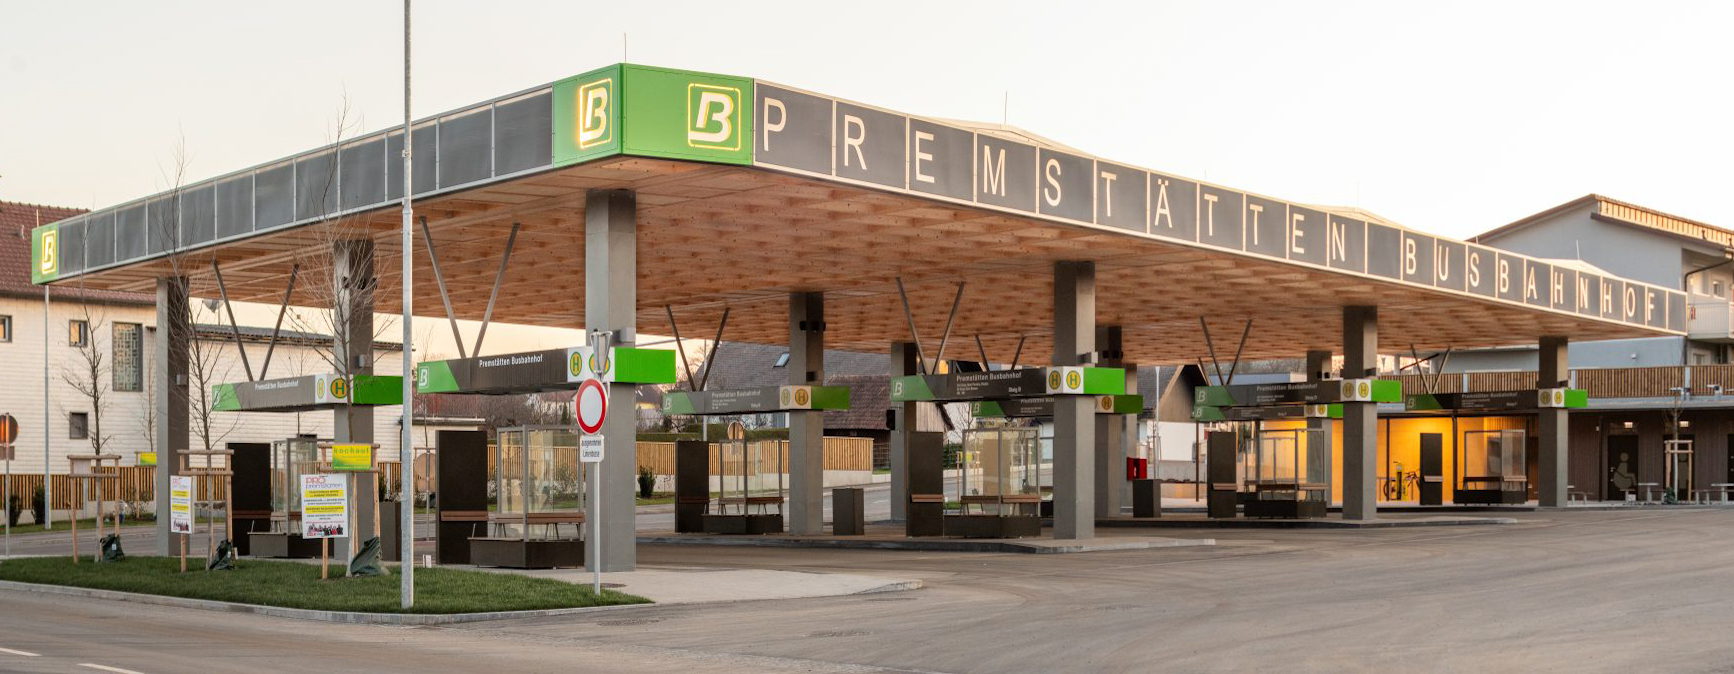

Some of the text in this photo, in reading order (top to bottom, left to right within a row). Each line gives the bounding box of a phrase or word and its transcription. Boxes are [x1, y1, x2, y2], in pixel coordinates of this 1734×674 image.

[580, 87, 608, 146] B
[688, 91, 735, 143] B
[763, 96, 1656, 321] PREMSTÄTTEN BUSBAHNHOF
[478, 353, 544, 368] Premstätten Busbahnhof
[956, 371, 1022, 383] Premstätten Busbahnhof
